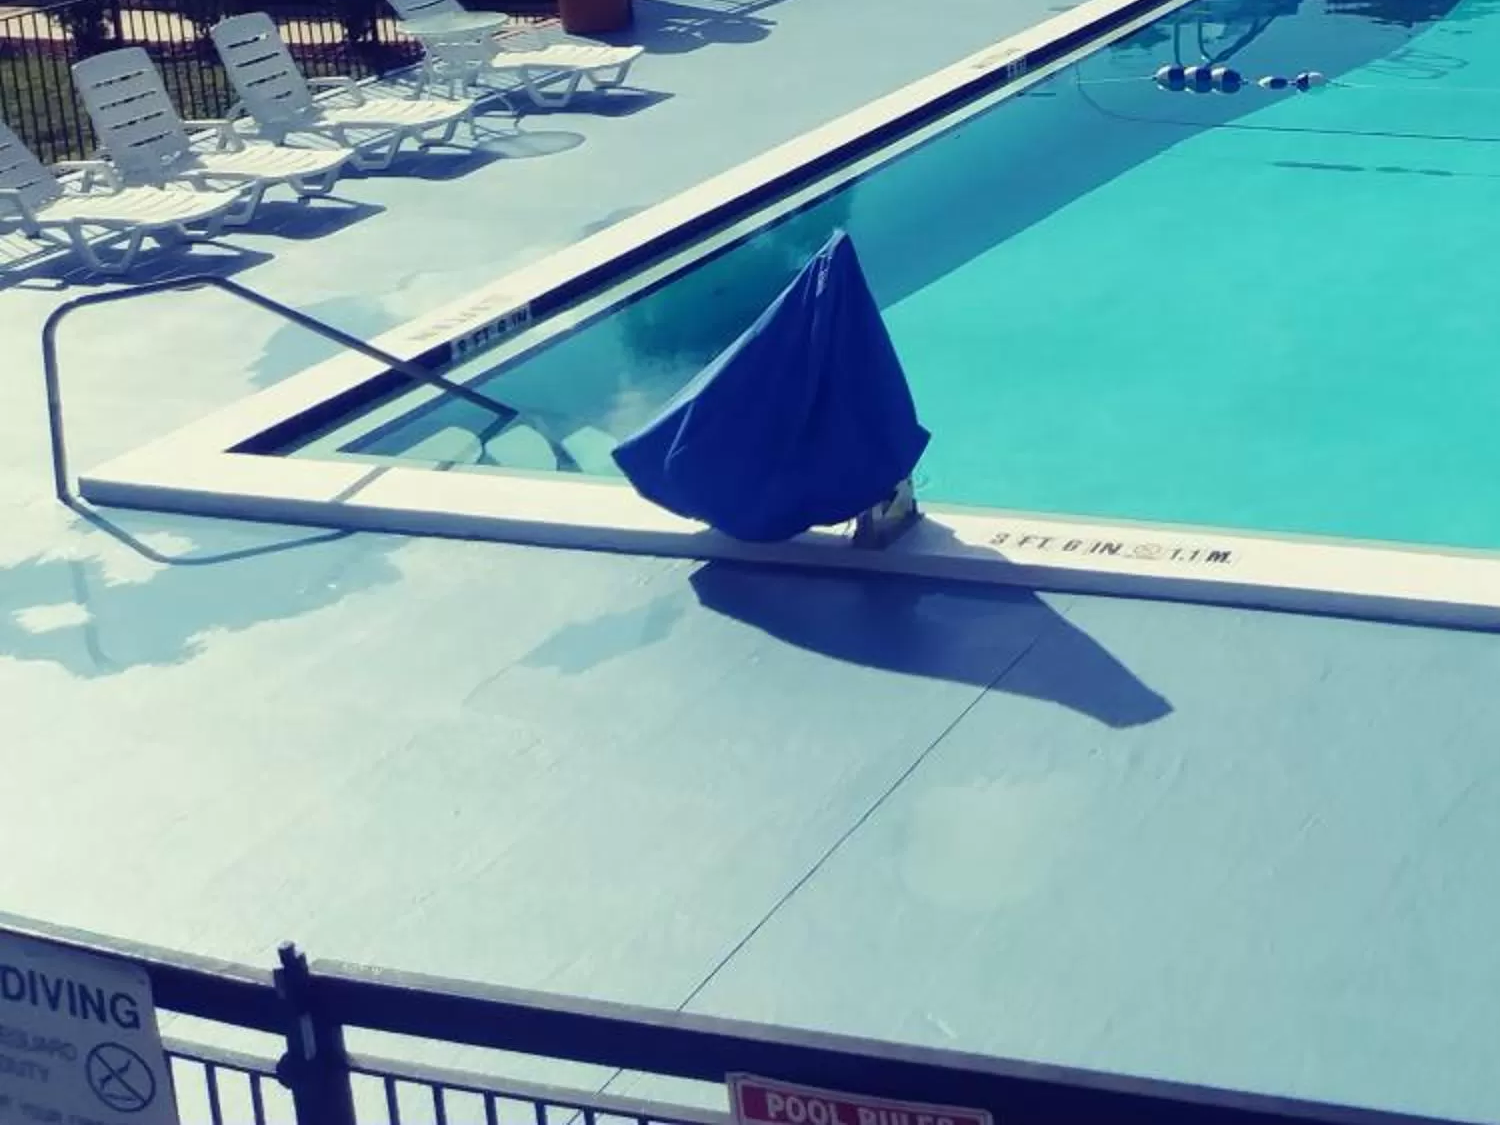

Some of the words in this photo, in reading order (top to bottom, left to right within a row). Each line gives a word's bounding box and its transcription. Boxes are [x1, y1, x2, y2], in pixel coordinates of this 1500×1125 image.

[990, 531, 1009, 545] 3
[1019, 533, 1053, 550] FT
[1062, 538, 1080, 552] 6
[0, 965, 140, 1030] DIVING
[765, 1091, 848, 1125] POOL
